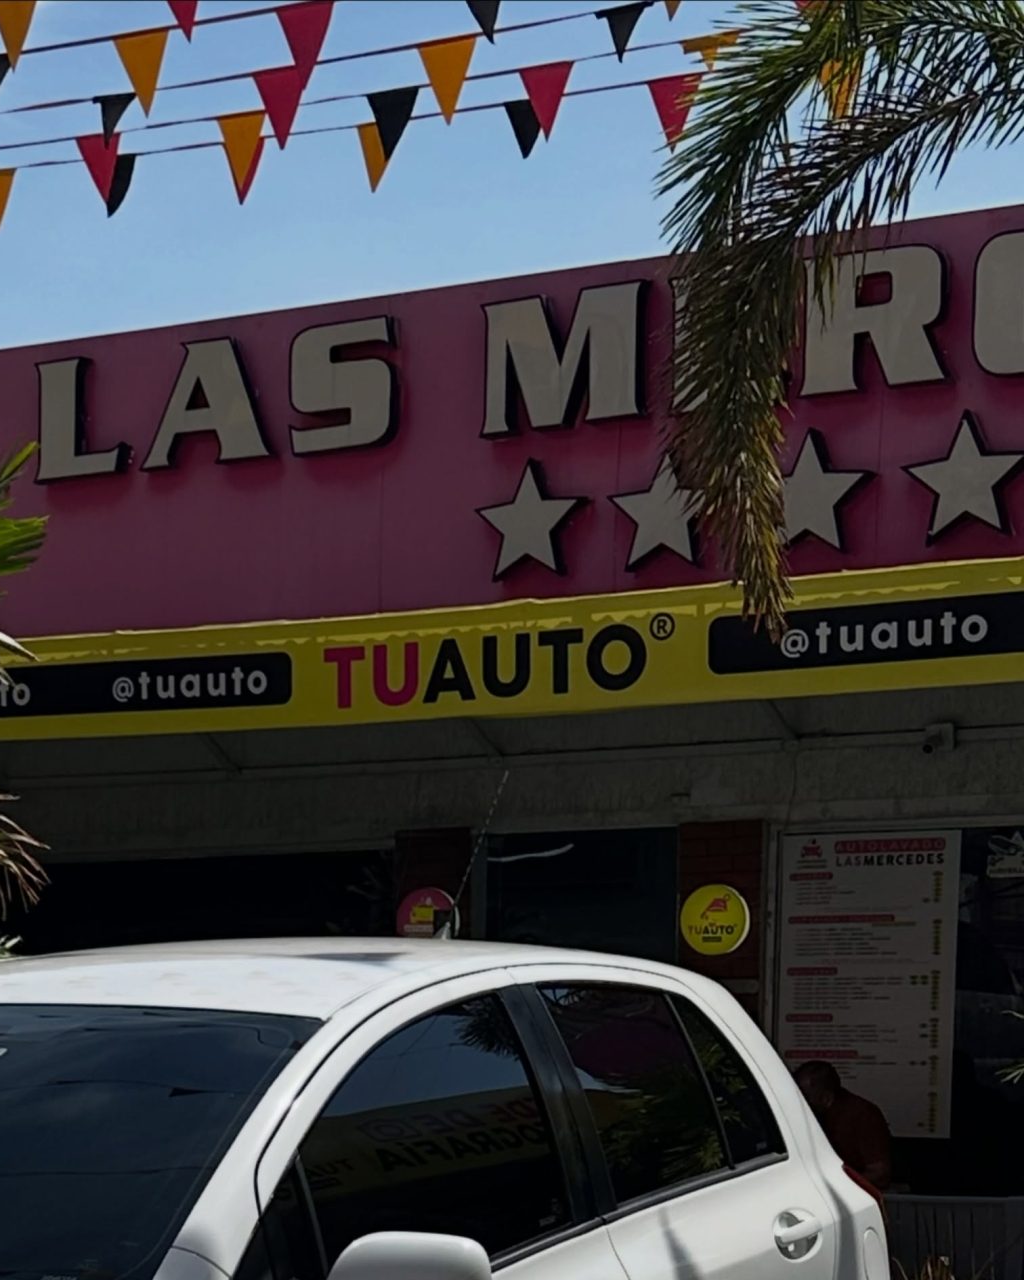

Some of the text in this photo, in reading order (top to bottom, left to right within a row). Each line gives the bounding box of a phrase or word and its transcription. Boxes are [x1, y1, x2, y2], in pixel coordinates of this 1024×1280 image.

[35, 315, 398, 485] LAS
[780, 610, 988, 658] @tuauto
[112, 667, 268, 702] @tuauto
[835, 838, 945, 853] AUTOLAVADO
